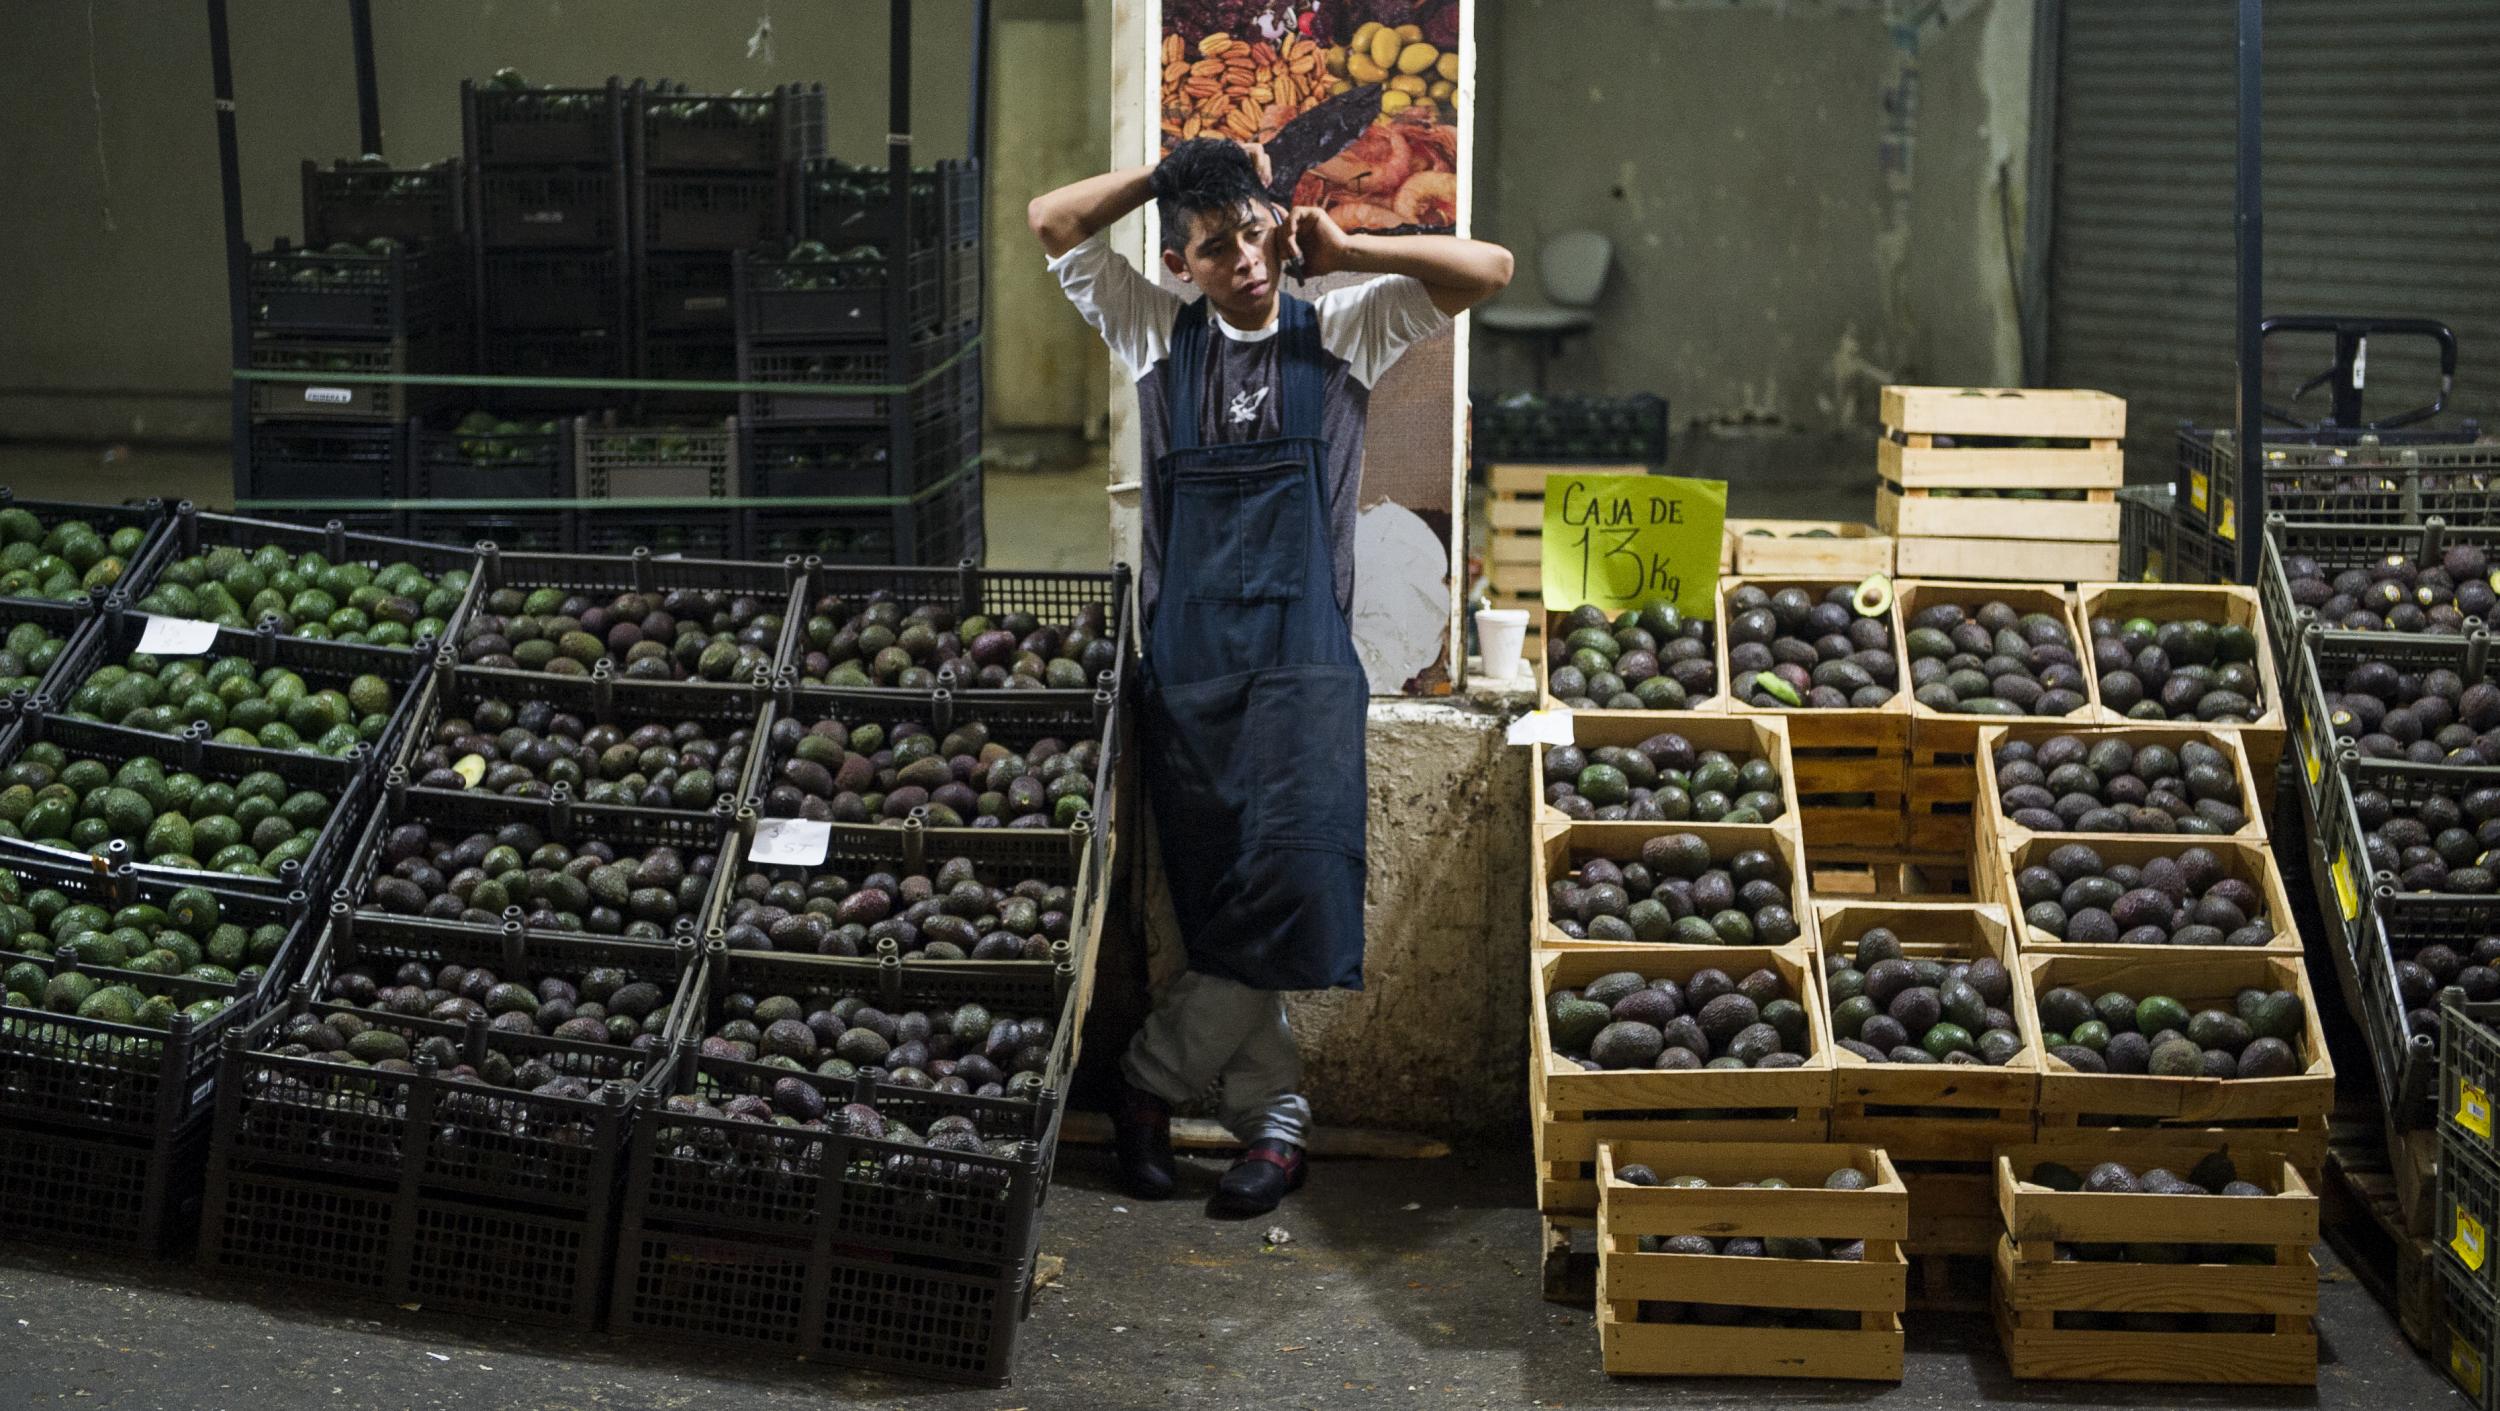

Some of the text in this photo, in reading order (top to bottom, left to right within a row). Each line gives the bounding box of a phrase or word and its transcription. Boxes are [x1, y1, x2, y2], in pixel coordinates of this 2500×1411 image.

[1562, 481, 1684, 526] CAJA DE
[1571, 526, 1681, 603] 13 Kg
